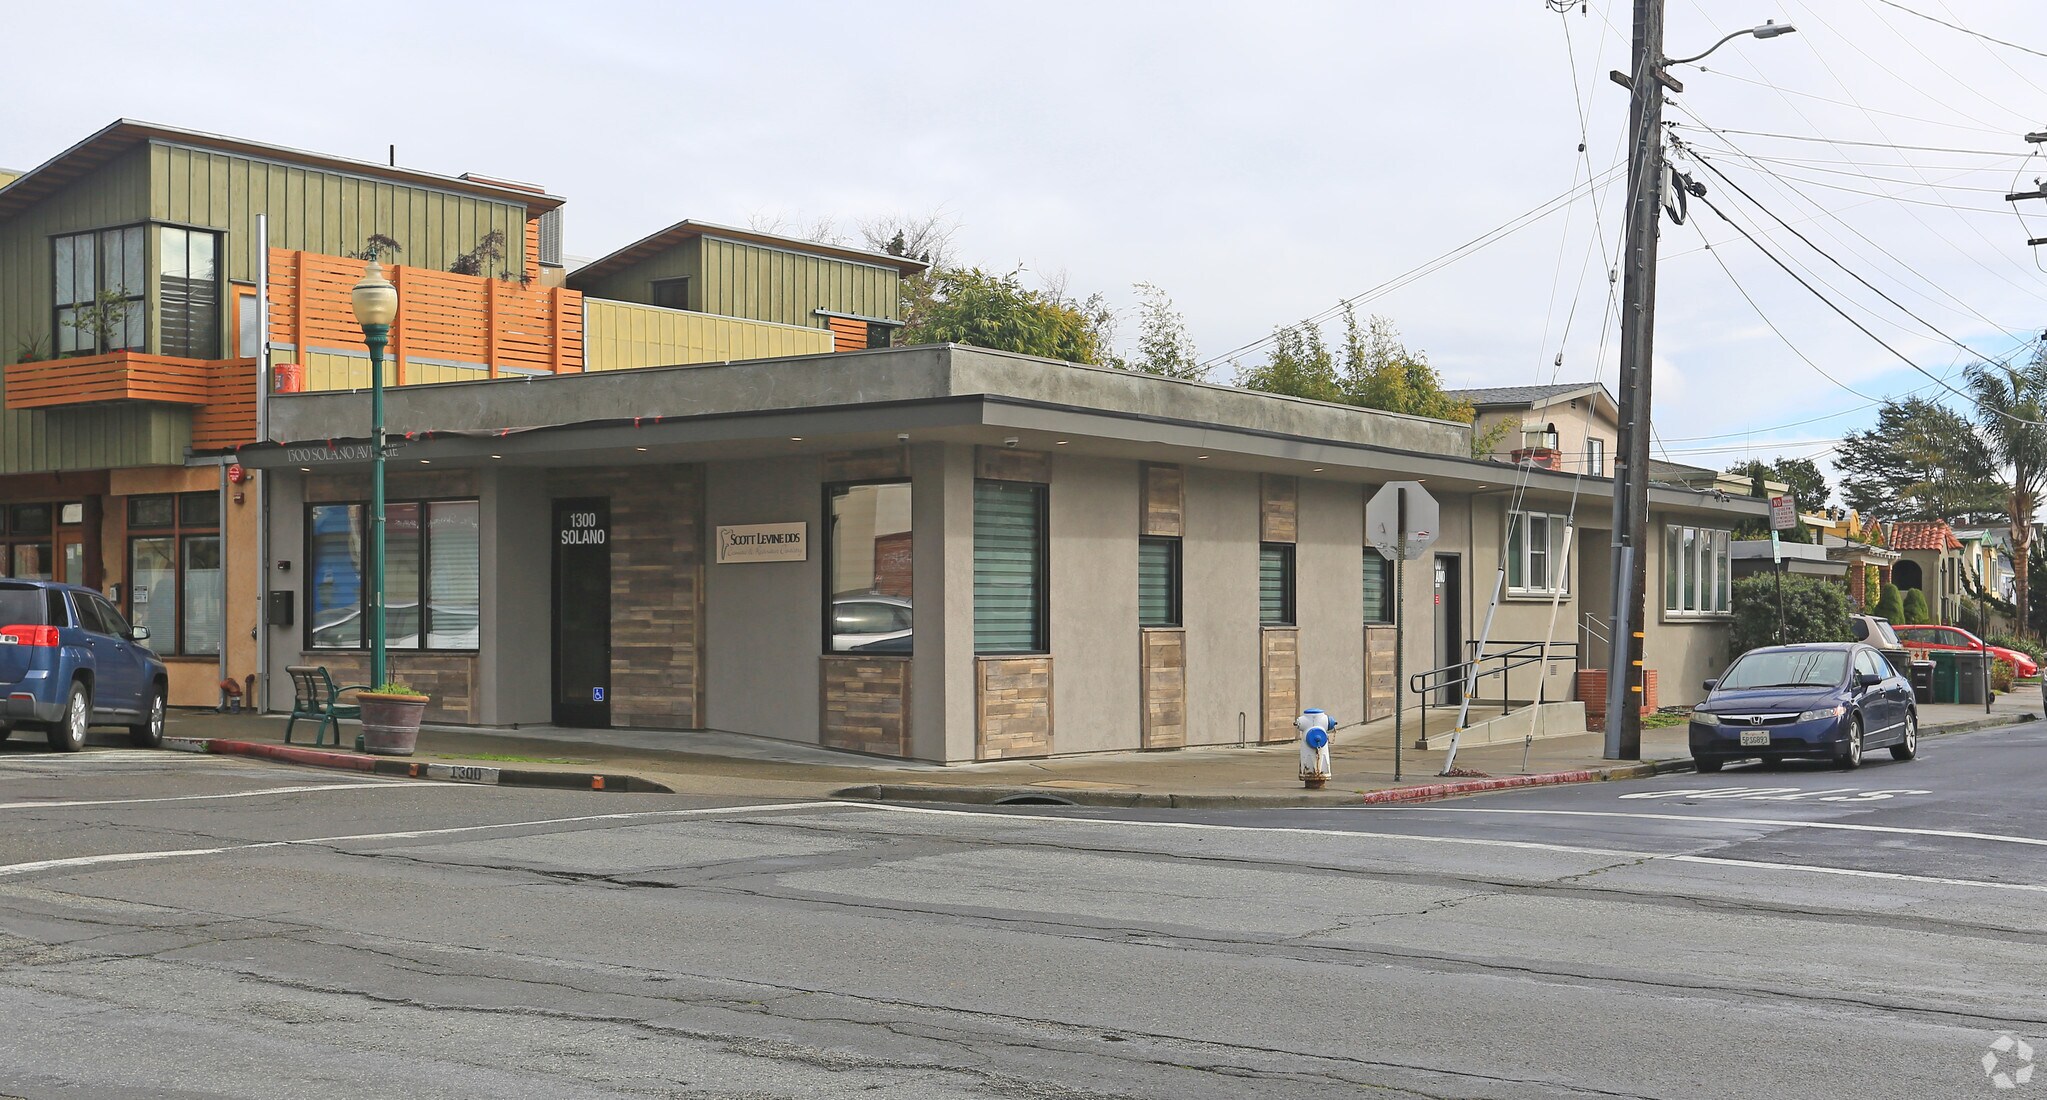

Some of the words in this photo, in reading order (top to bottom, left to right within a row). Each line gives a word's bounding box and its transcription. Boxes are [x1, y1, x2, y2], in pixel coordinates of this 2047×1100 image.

[287, 448, 311, 462] 1300
[311, 446, 355, 461] SOLANO
[570, 512, 596, 528] 1300
[561, 529, 605, 545] SOLANO
[784, 532, 801, 544] DDS
[450, 765, 482, 780] 1300
